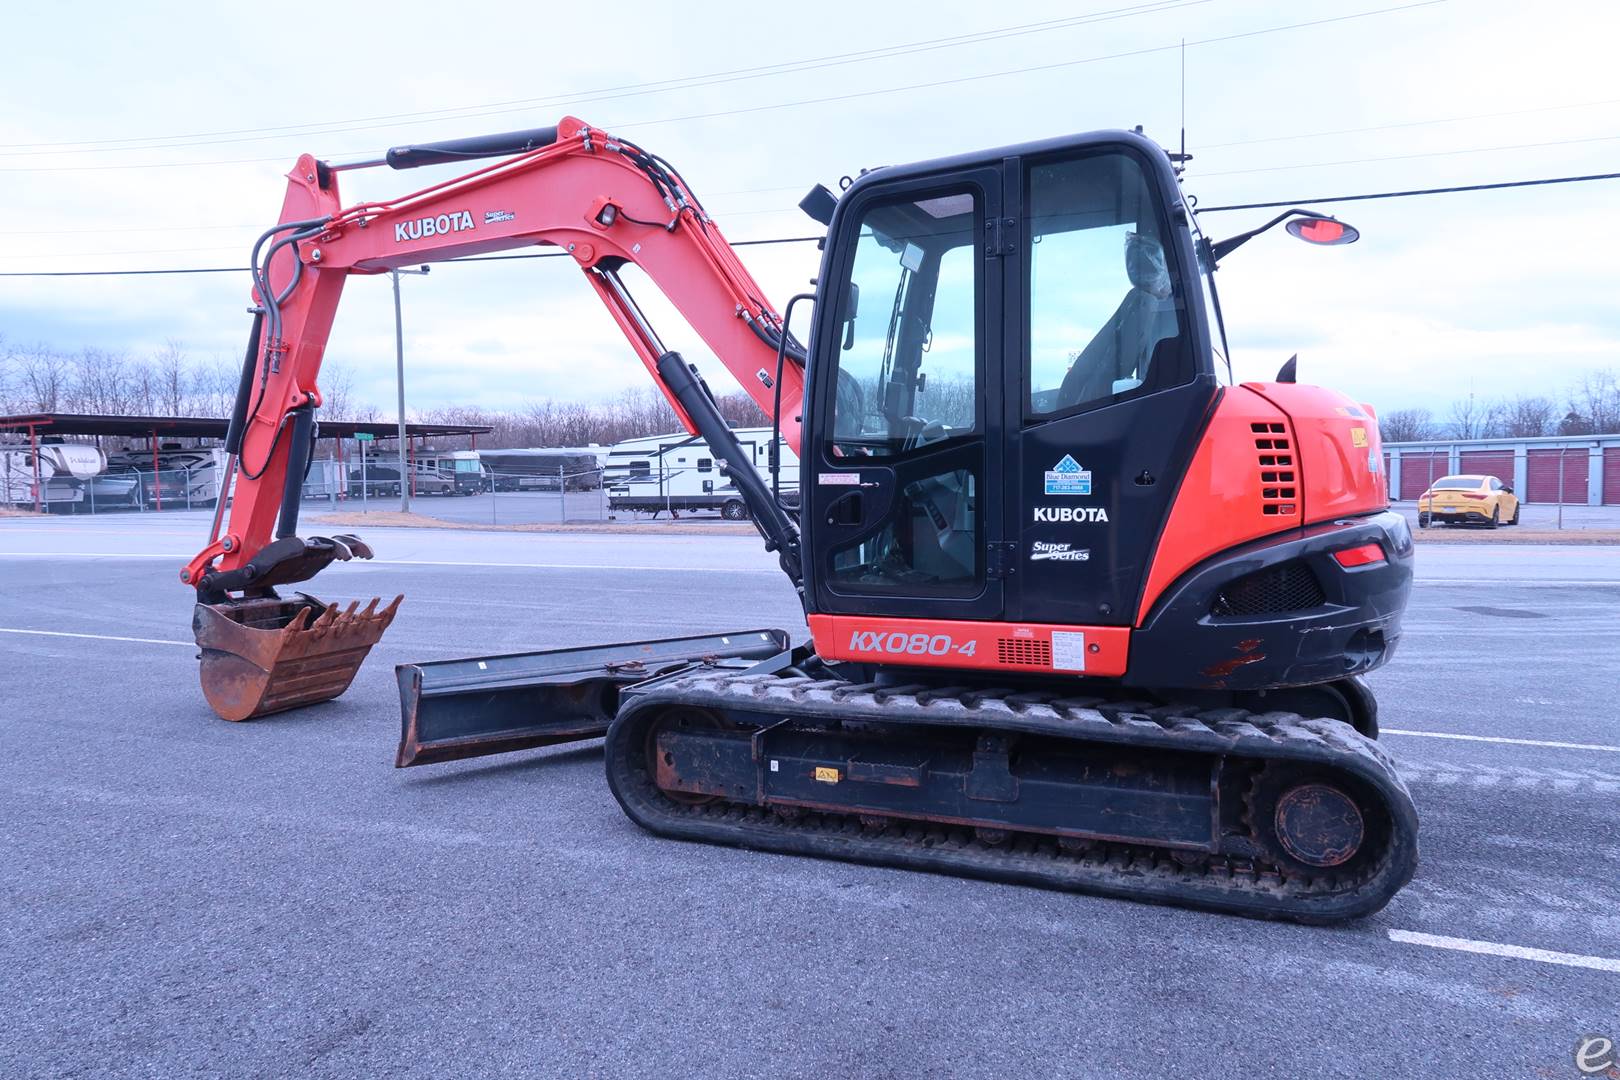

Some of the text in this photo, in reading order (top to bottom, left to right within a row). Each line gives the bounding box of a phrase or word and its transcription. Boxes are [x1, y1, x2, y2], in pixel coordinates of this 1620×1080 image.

[394, 210, 475, 242] KUBOTA
[1034, 507, 1109, 522] KUBOTA
[1032, 541, 1072, 554] Super
[1050, 550, 1090, 561] Series
[849, 630, 977, 657] KX080-4
